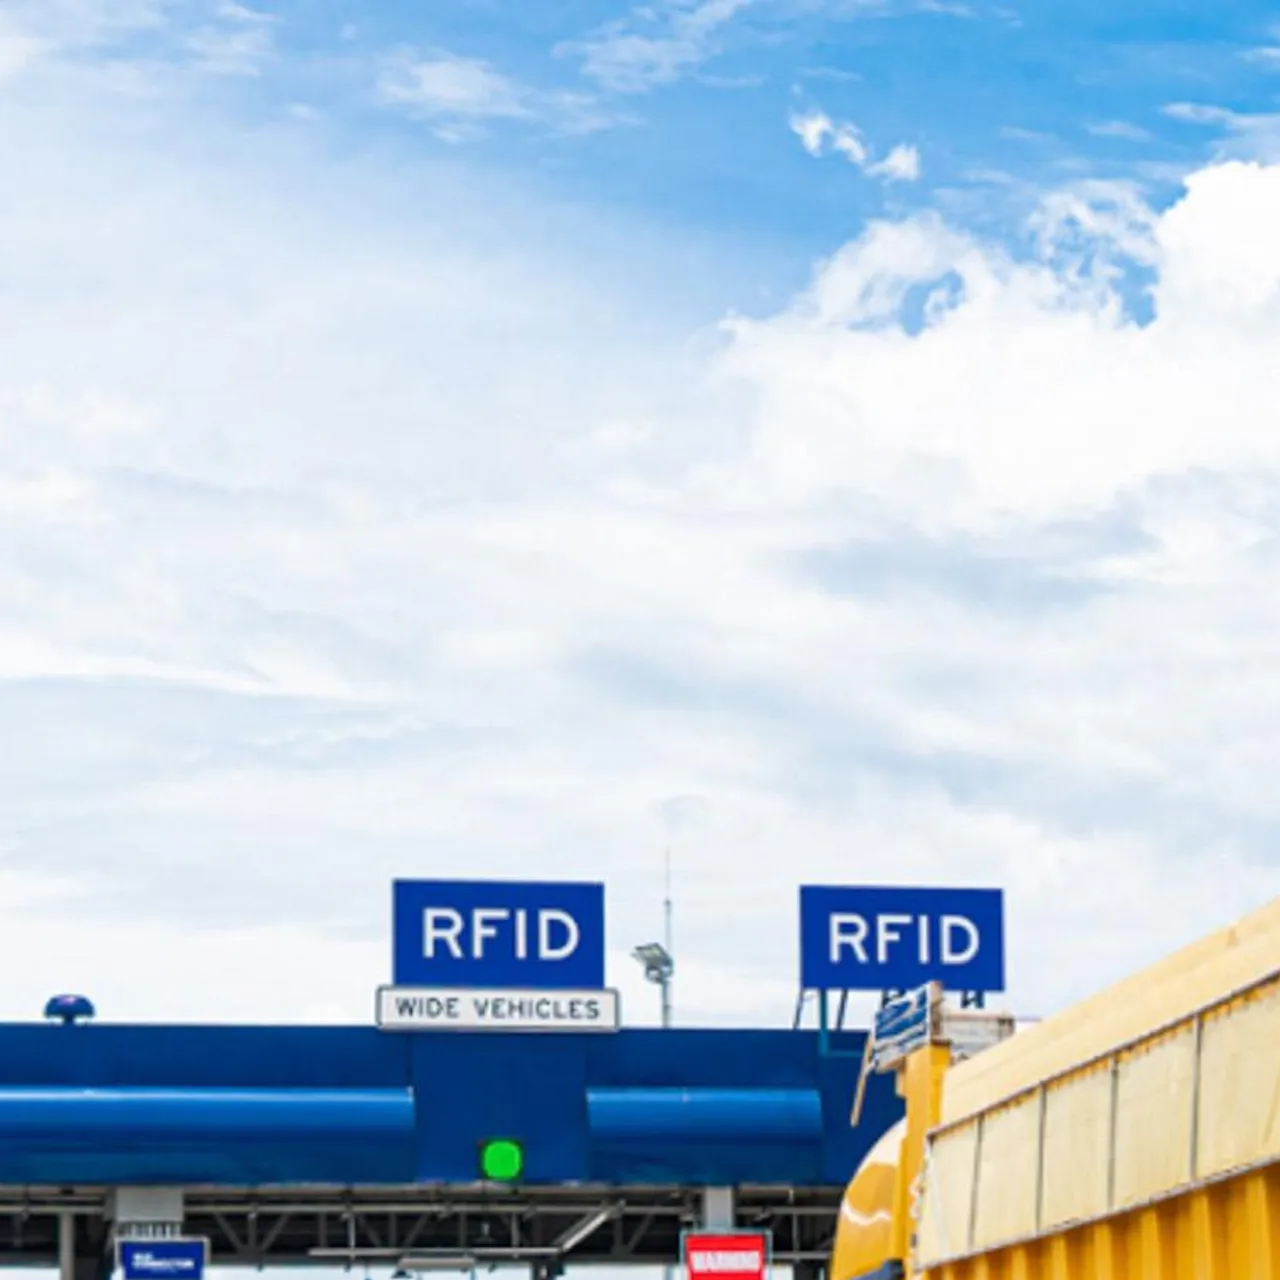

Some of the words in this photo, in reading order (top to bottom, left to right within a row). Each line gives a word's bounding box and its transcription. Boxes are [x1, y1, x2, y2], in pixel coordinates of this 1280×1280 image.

[423, 907, 579, 960] RFID
[829, 912, 979, 965] RFID
[395, 997, 460, 1018] WIDE
[473, 997, 601, 1020] VEHICLES
[690, 1250, 761, 1274] WARNING
